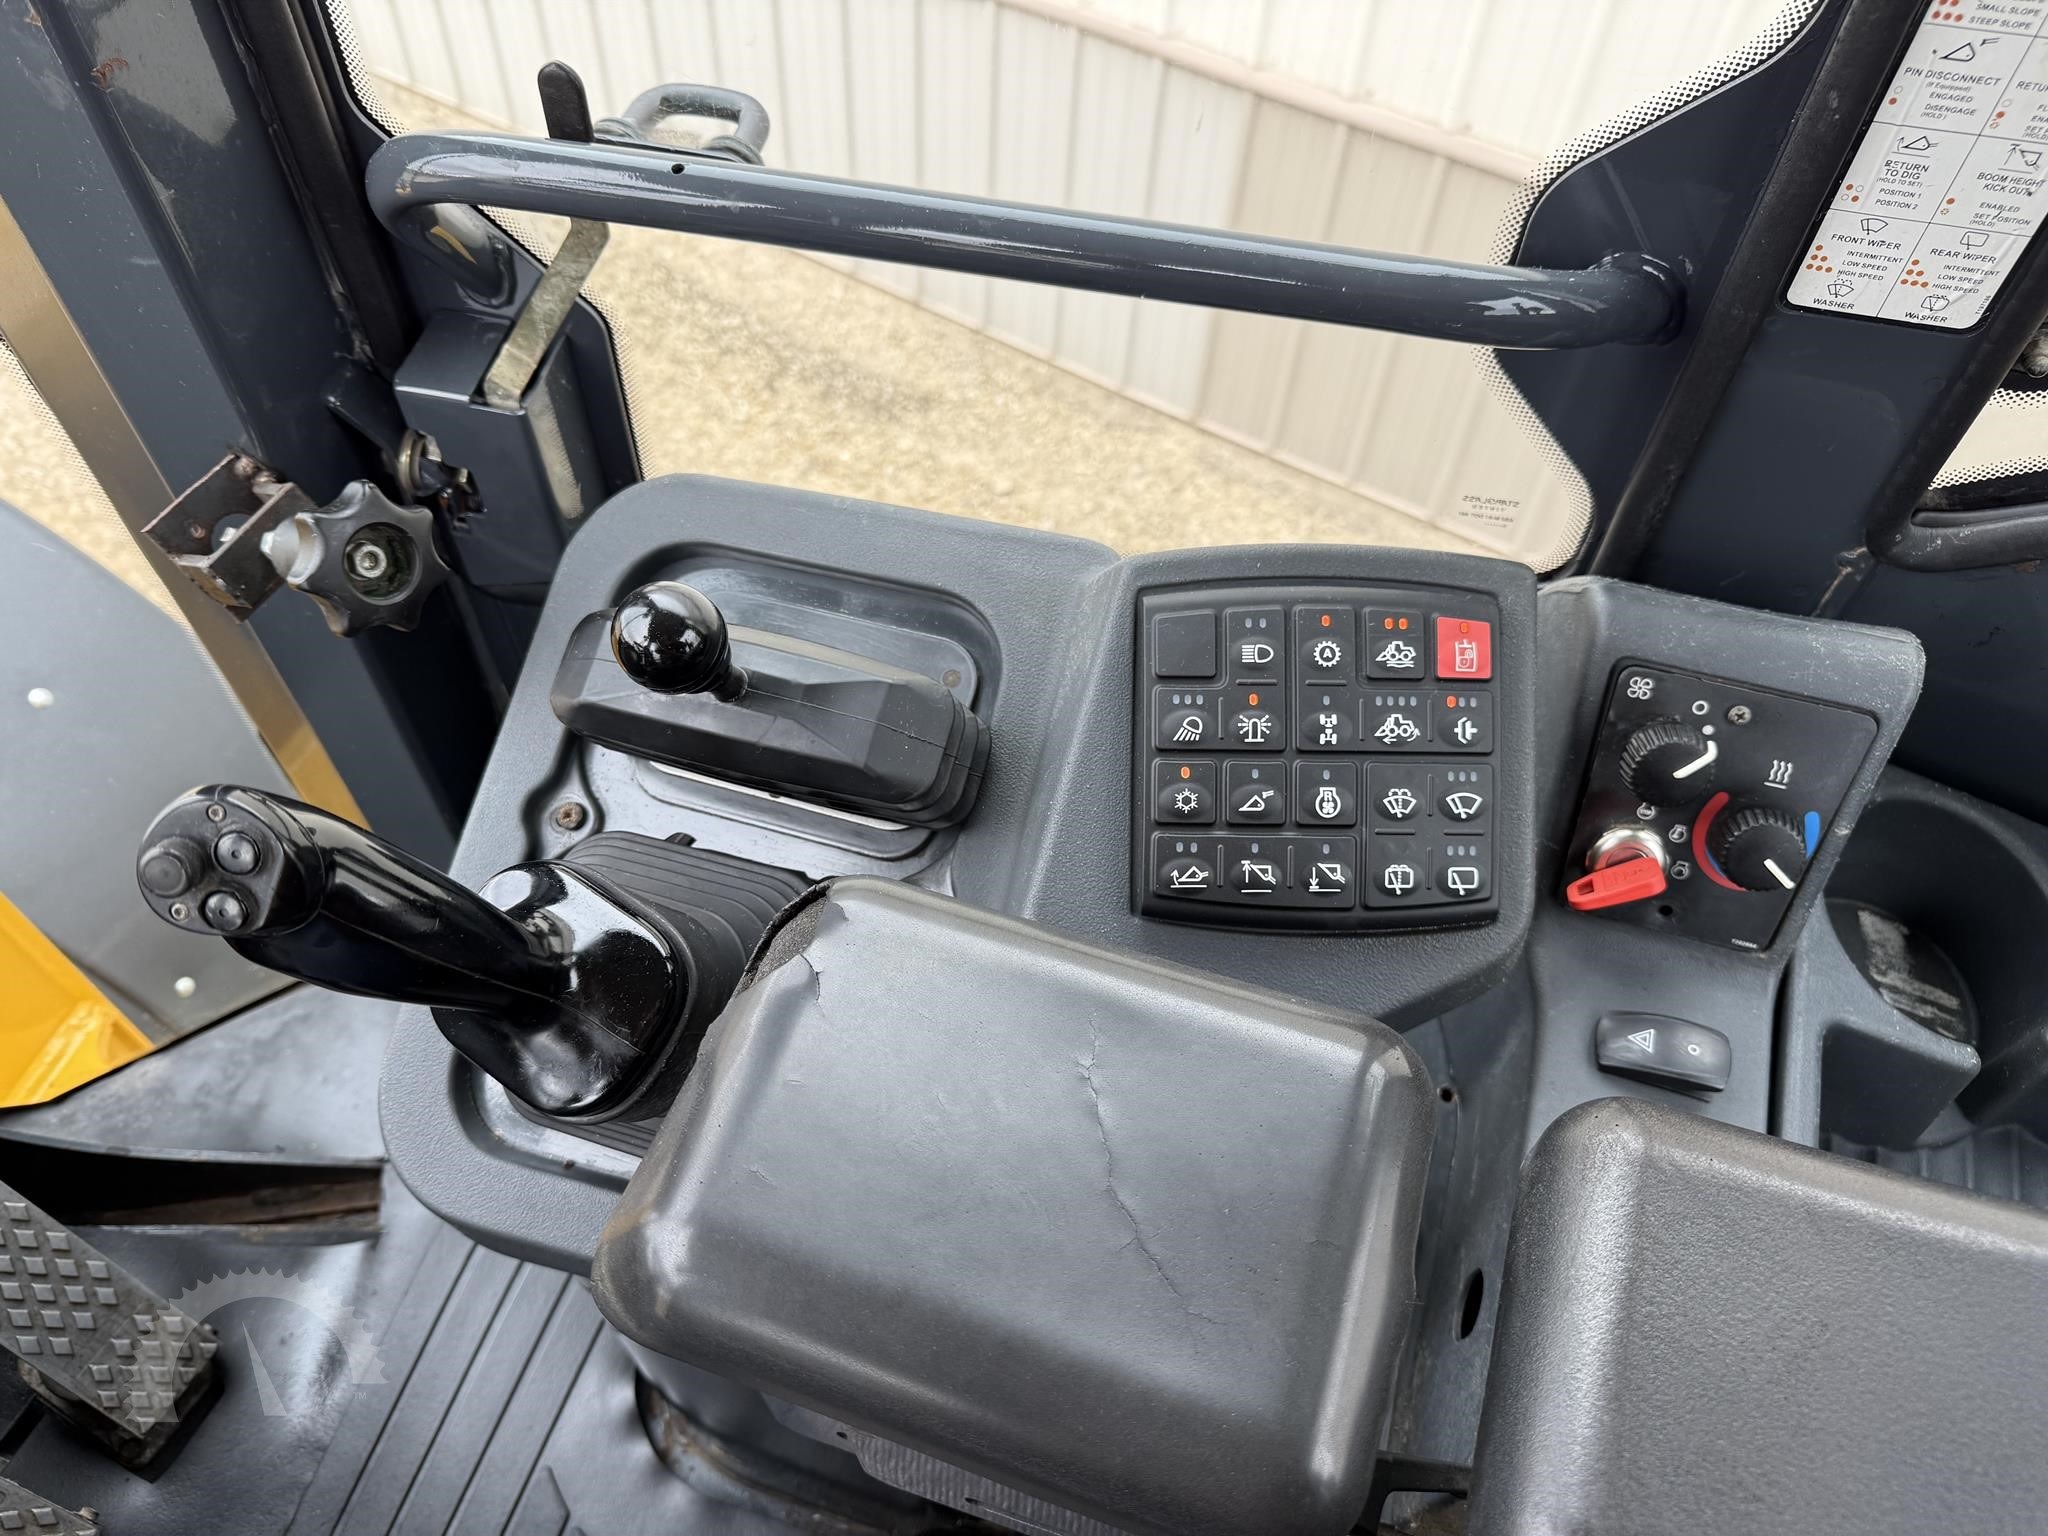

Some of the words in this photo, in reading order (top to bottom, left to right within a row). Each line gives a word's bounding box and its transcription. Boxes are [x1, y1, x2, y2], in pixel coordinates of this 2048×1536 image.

[1976, 3, 2005, 13] SMALL
[2008, 6, 2041, 16] SLOPE
[1969, 16, 1999, 25] STEEP
[2000, 20, 2032, 30] SLOPE
[1903, 67, 1922, 78] PIN
[1925, 70, 2002, 87] DISCONNECT
[1929, 91, 1973, 103] ENGAGED
[1924, 103, 1976, 116] DISENGAGE
[1884, 159, 1929, 173] RETURN
[1885, 169, 1899, 178] TO
[1900, 170, 1920, 181] DIG
[1976, 172, 2009, 183] BOOM
[2009, 177, 2046, 188] HEIGHT
[1897, 178, 1906, 186] TO
[1878, 187, 1917, 198] POSITION
[1982, 182, 2007, 193] KICK
[2008, 186, 2031, 196] OUT
[1875, 198, 1911, 209] POSITION
[1979, 202, 2020, 212] ENABLED
[1973, 212, 1991, 220] SET
[1969, 219, 1995, 228] (HOLD)
[1831, 233, 1866, 245] FRONT
[1866, 238, 1902, 251] WIPER
[1846, 250, 1903, 264] INTERMITTENT
[1929, 248, 1961, 259] REAR
[1962, 252, 1997, 264] WIPER
[1842, 259, 1861, 268] LOW
[1861, 263, 1888, 272] SPEED
[1943, 264, 2000, 277] INTERMITTENT
[1837, 269, 1857, 277] HIGH
[1857, 272, 1884, 281] SPEED
[1937, 273, 1957, 281] LOW
[1957, 276, 1984, 285] SPEED
[1931, 283, 1953, 291] HIGH
[1953, 284, 1980, 294] SPEED
[1812, 297, 1855, 310] WASHER
[1904, 311, 1948, 323] WASHER
